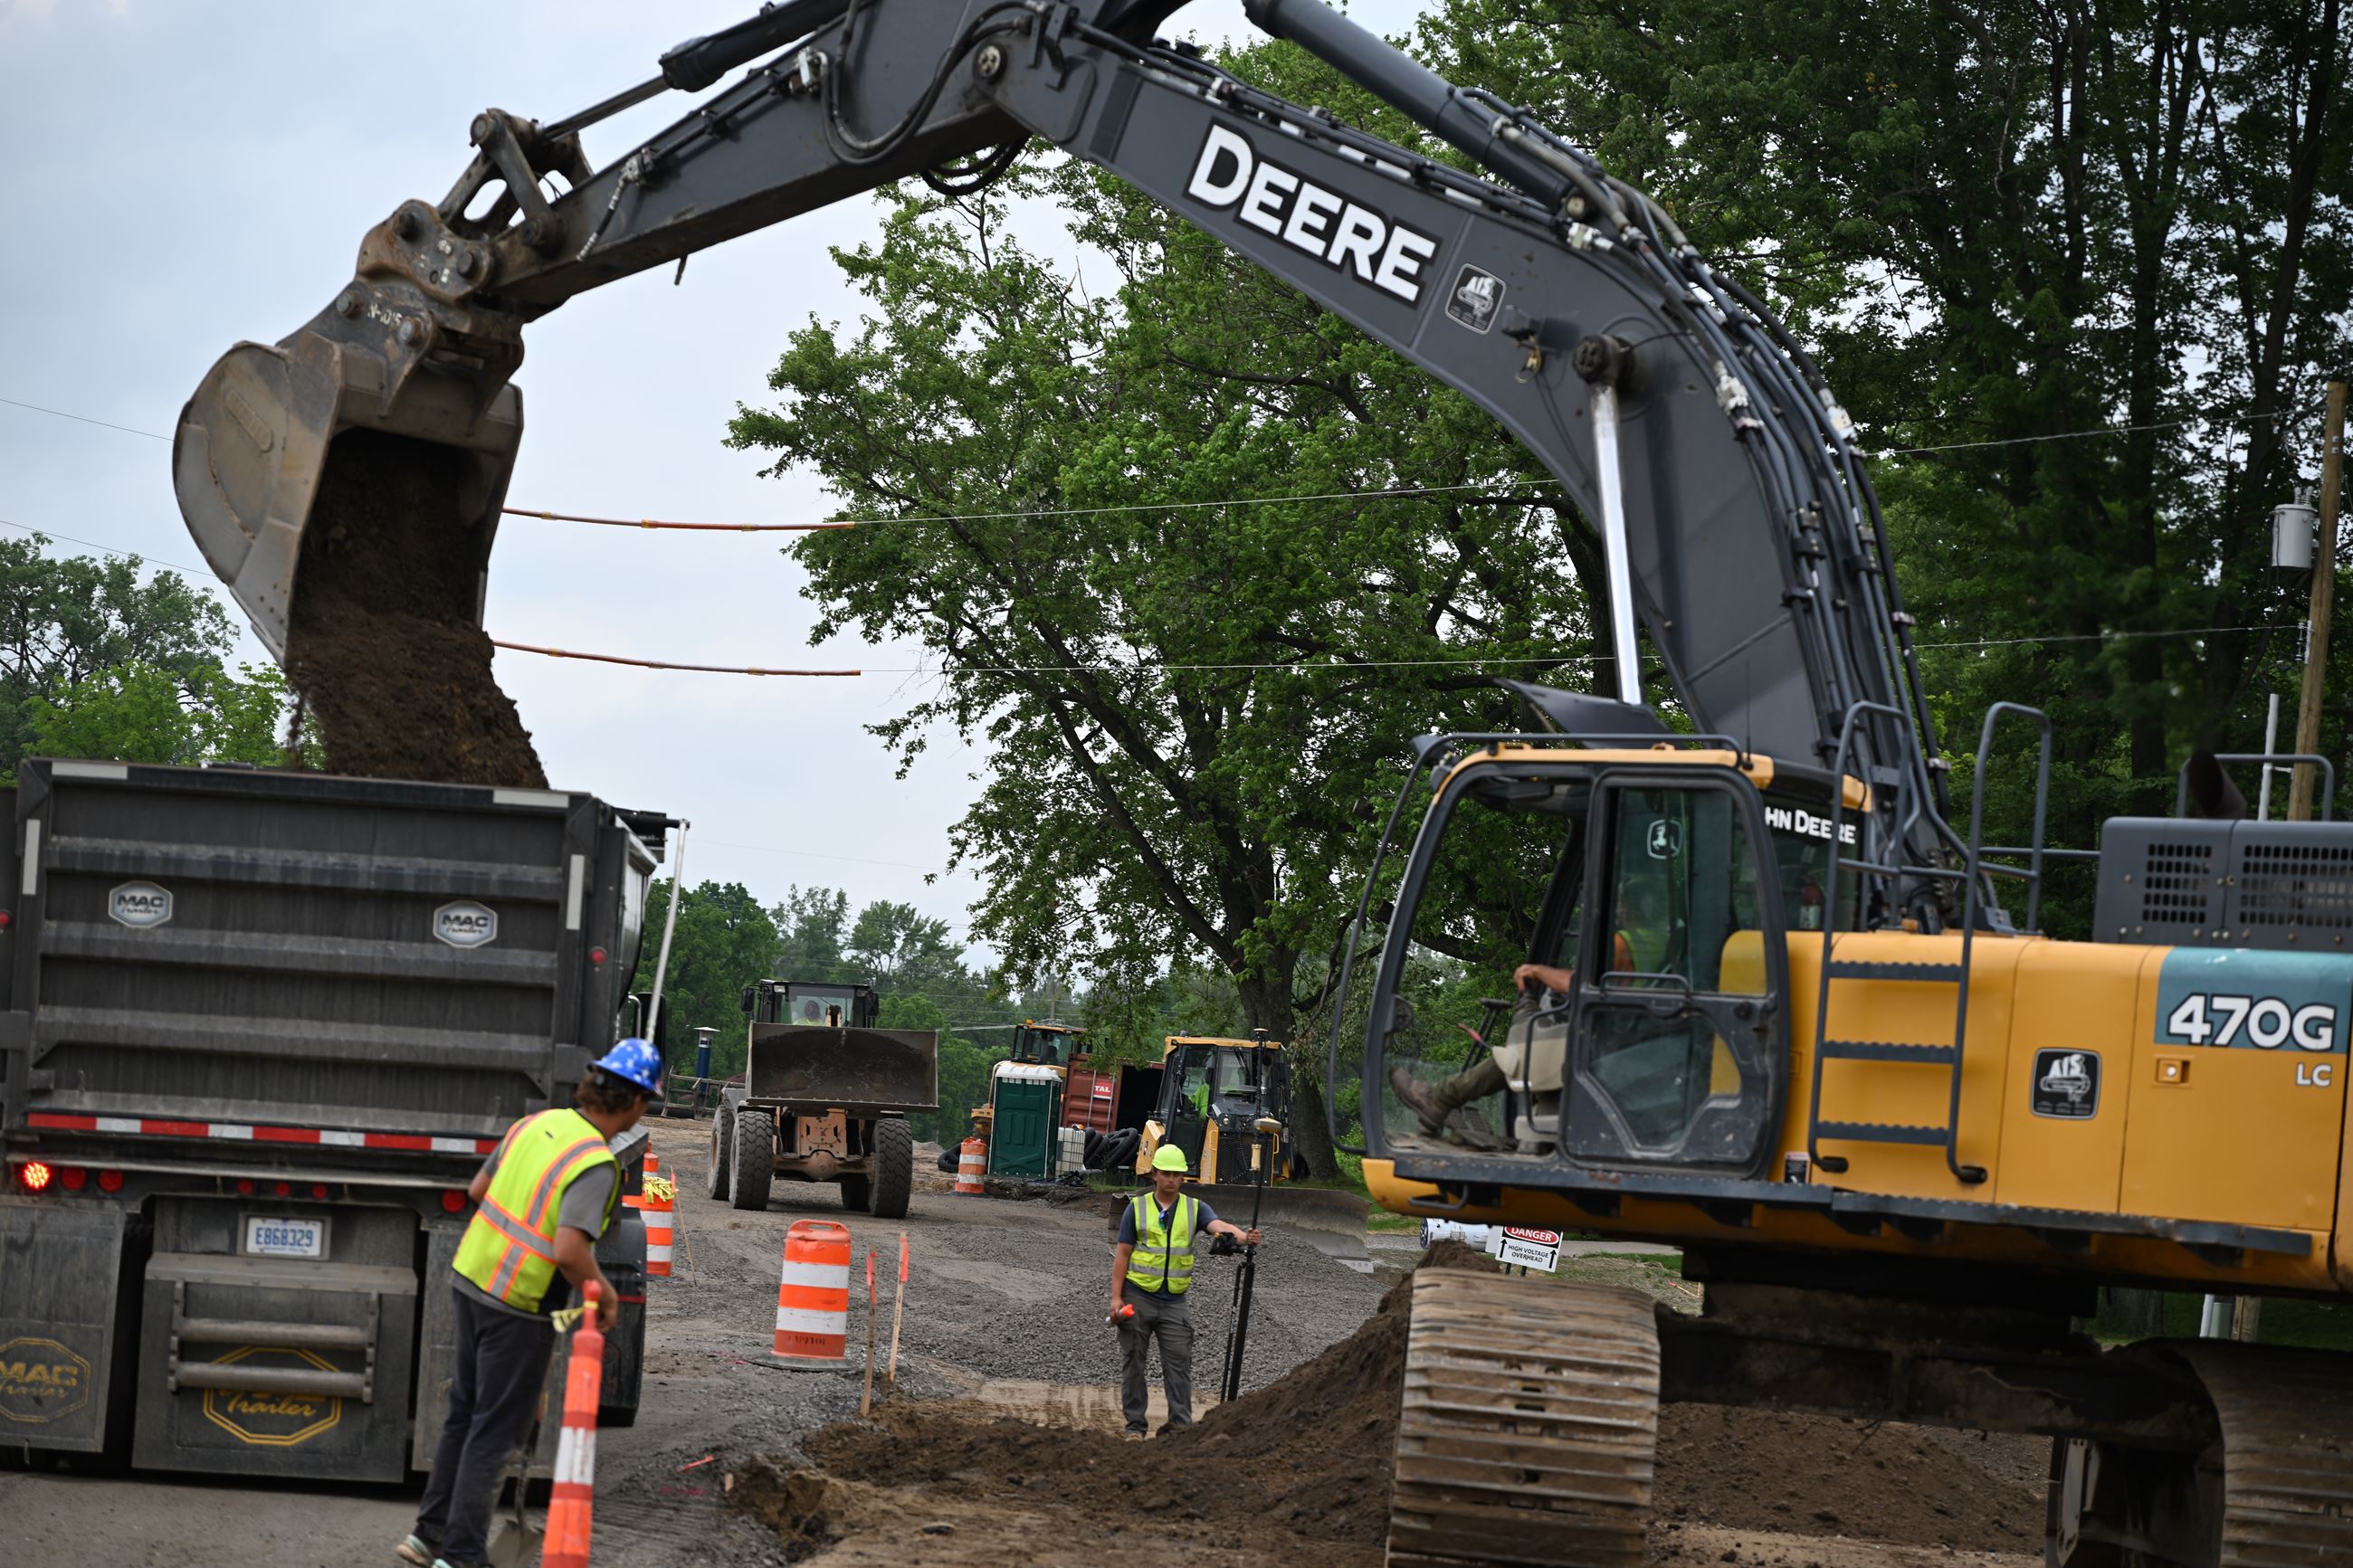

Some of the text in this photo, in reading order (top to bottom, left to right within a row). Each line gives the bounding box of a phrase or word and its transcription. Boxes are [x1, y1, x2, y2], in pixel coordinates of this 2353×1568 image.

[1187, 123, 1437, 302] DEERE
[1764, 805, 1792, 831] HN
[117, 894, 165, 908] MAC
[442, 915, 489, 927] MAC
[2167, 993, 2337, 1051] 470G
[2048, 1053, 2086, 1079] AIS
[2296, 1062, 2333, 1087] LC
[1094, 1085, 1111, 1093] TAL
[255, 1227, 314, 1248] E868329
[1510, 1227, 1552, 1242] DANGER
[1508, 1244, 1548, 1259] HIGH VOLTAGE
[1511, 1252, 1543, 1263] OVERHEAD
[226, 1392, 317, 1418] Trailer
